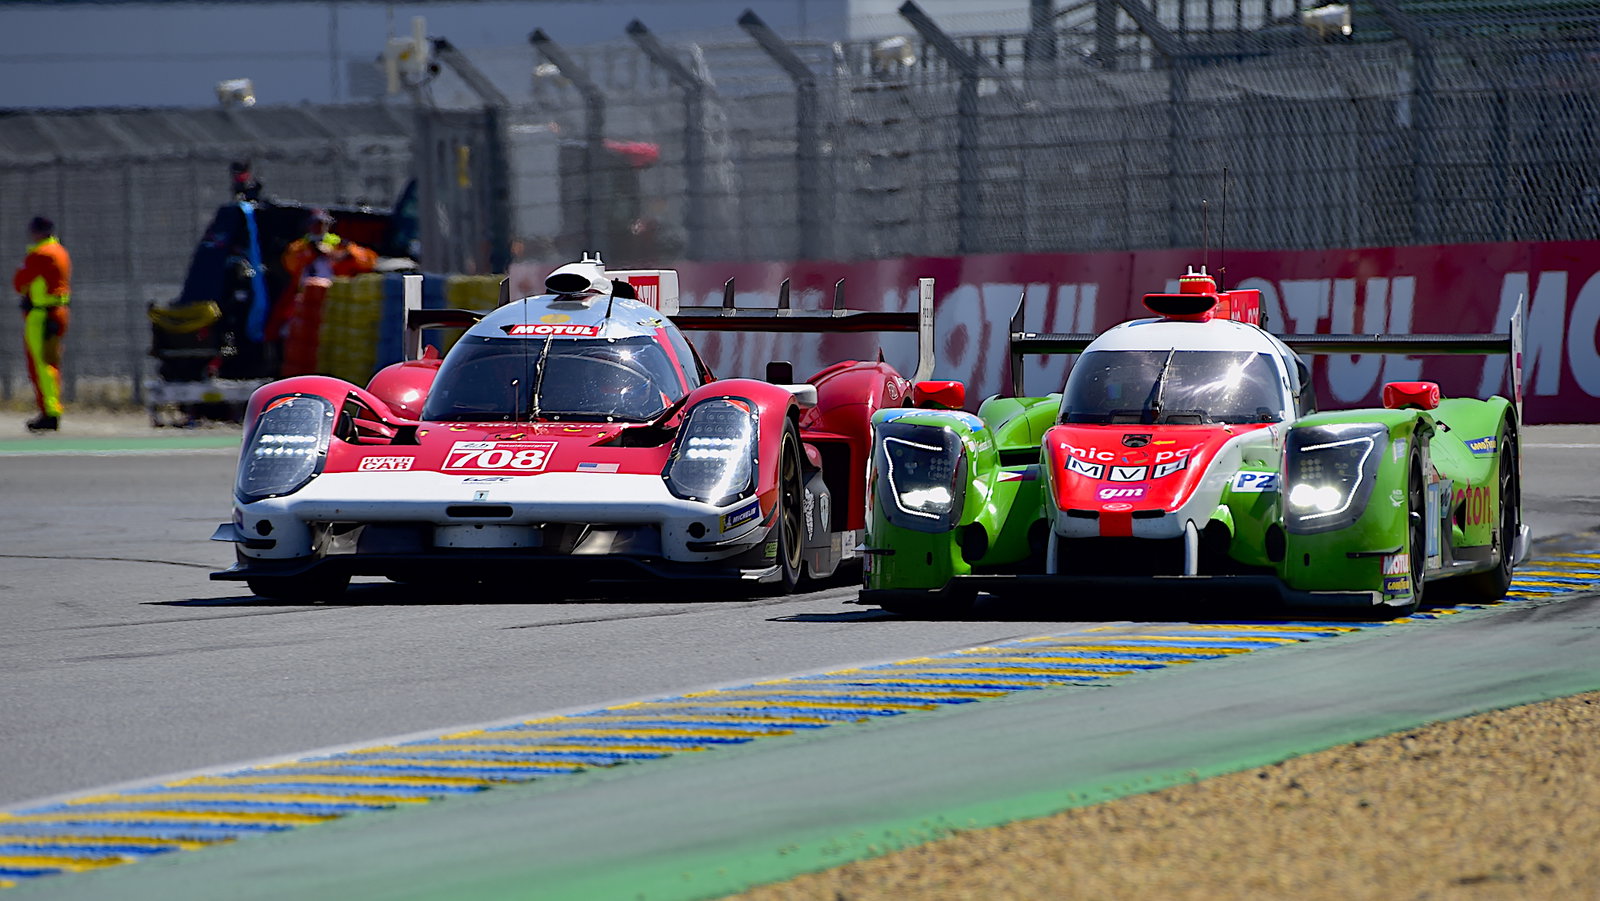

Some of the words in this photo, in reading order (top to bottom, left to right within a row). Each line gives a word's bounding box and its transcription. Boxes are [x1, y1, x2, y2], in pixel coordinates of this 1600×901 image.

[511, 325, 595, 335] MOTUL
[361, 462, 409, 470] CAR
[450, 449, 546, 469] 708
[1237, 473, 1276, 488] P2
[1099, 486, 1144, 500] gm
[732, 506, 757, 522] MICHELIN
